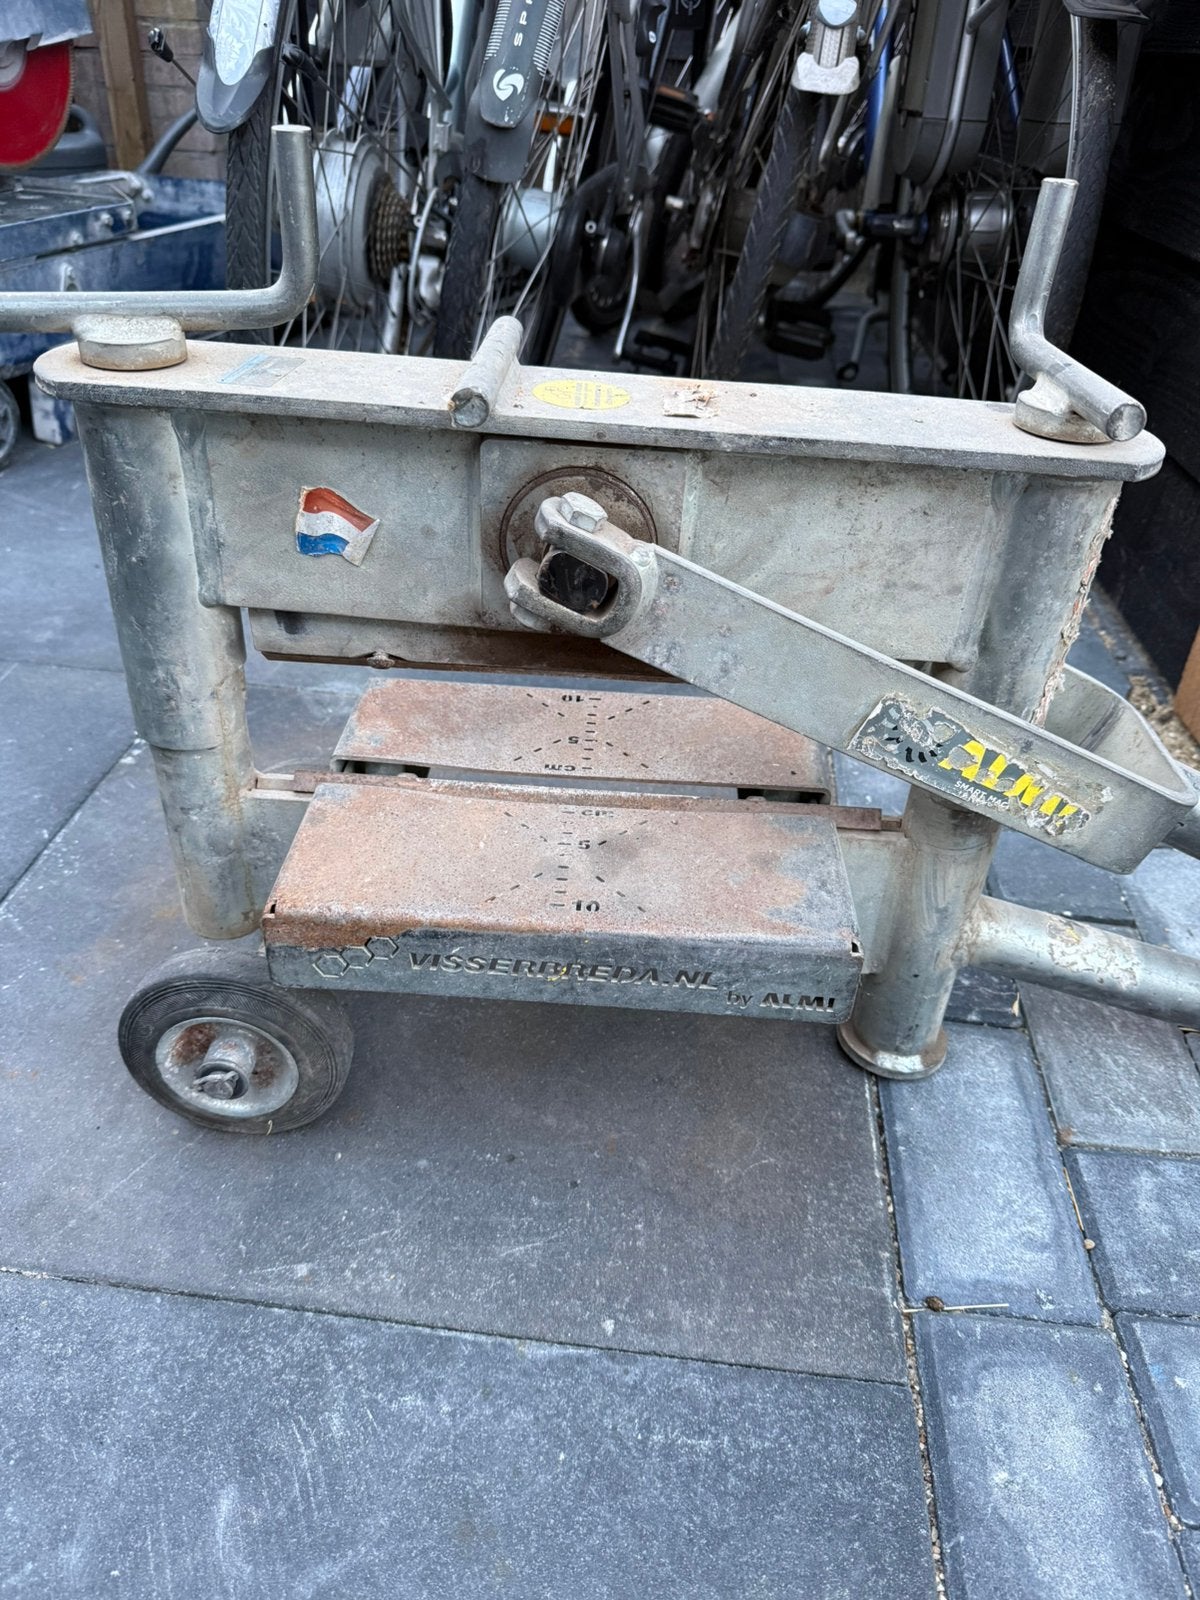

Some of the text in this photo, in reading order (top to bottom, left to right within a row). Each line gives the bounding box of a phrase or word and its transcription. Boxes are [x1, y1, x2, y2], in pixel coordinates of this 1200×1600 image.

[513, 0, 533, 47] SP
[561, 694, 584, 702] 10
[567, 736, 579, 744] 5
[544, 763, 576, 772] cm
[954, 780, 988, 800] SMART
[577, 839, 591, 850] 5
[571, 900, 600, 912] 10
[408, 951, 718, 991] VISSERBREDA.NL
[726, 990, 836, 1013] by ALMI
